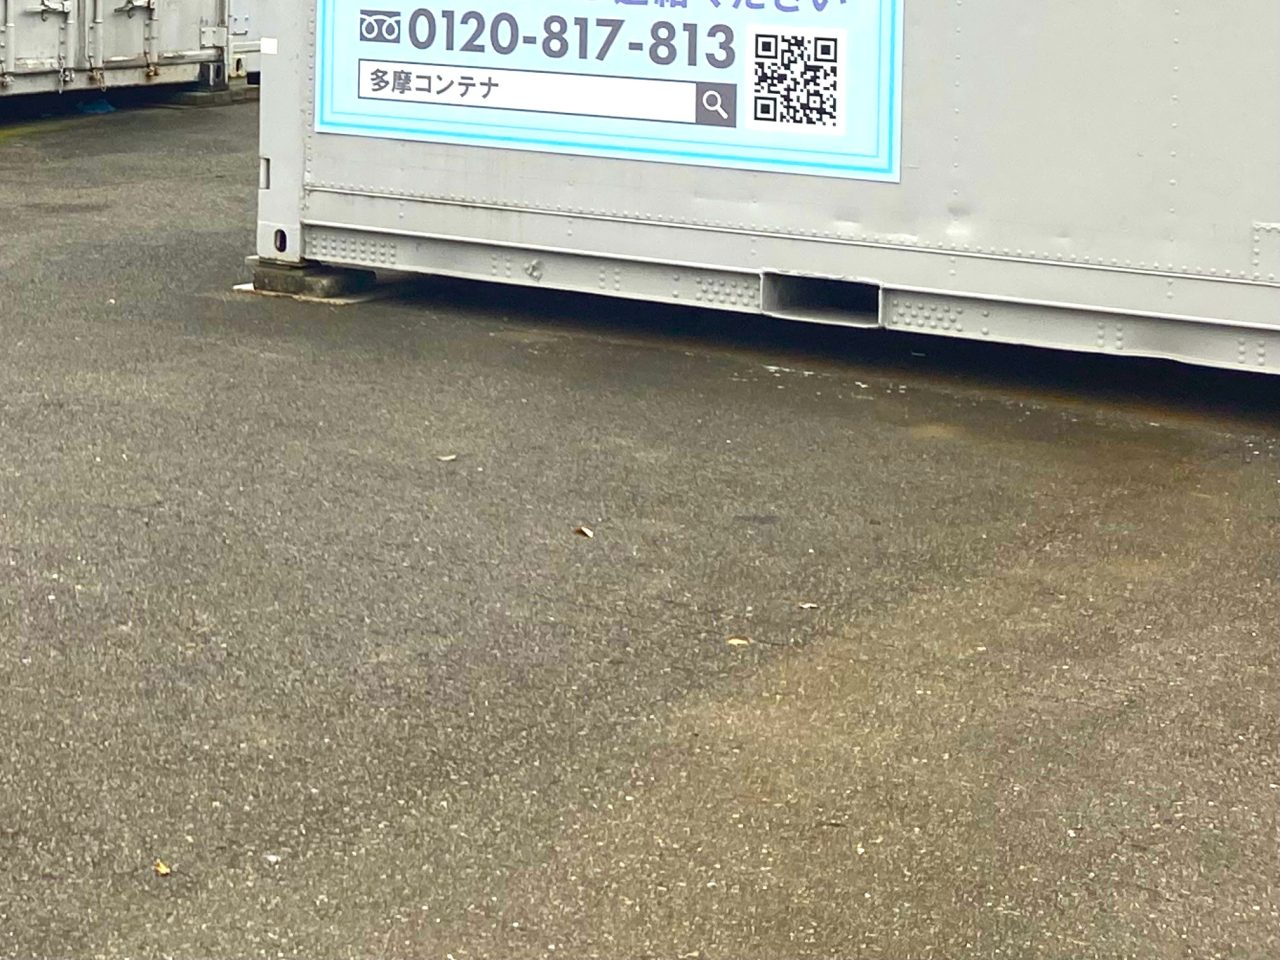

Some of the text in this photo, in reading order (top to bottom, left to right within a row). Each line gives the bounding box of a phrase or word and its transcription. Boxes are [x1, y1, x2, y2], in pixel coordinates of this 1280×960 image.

[407, 7, 737, 69] 0120-817-813
[369, 68, 501, 101] 多摩コンテナ
